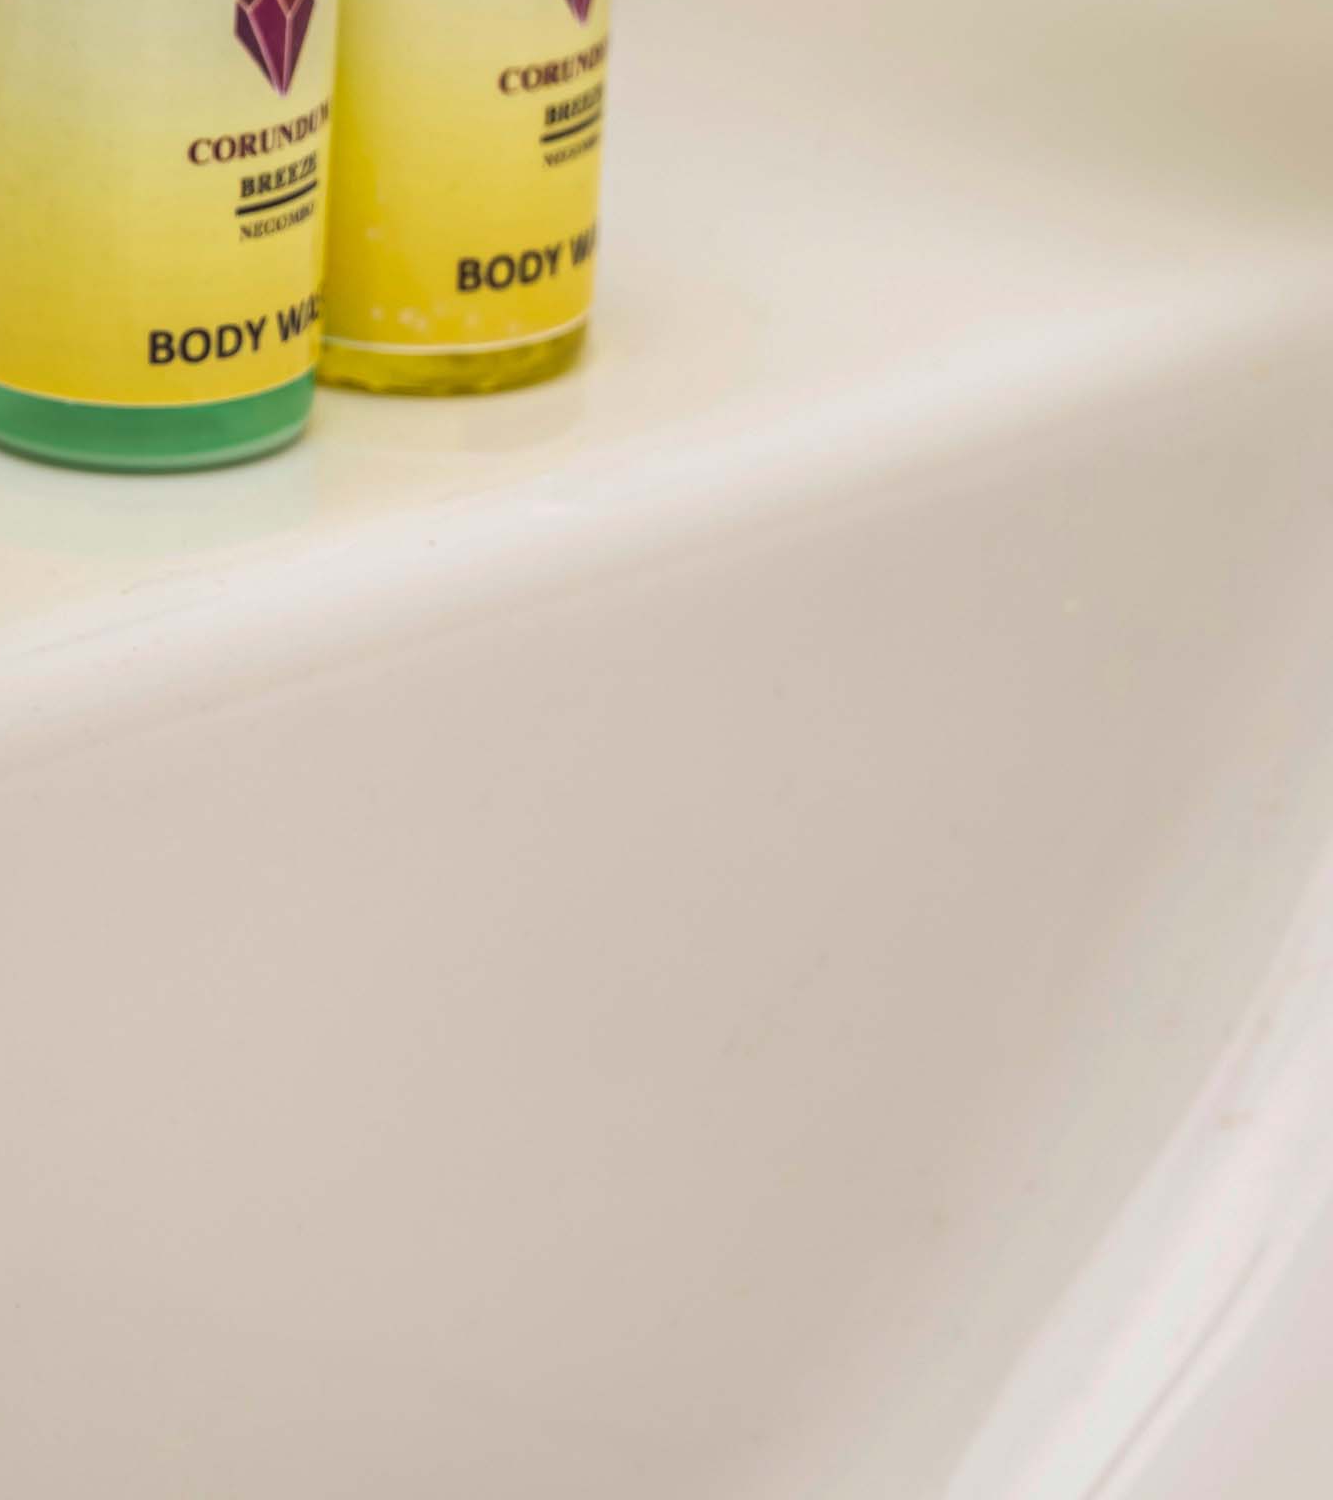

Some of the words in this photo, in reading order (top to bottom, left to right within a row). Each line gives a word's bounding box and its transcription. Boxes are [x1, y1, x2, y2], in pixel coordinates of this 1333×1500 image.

[240, 151, 318, 198] BREEZE
[457, 240, 562, 293] BODY
[148, 314, 267, 366] BODY
